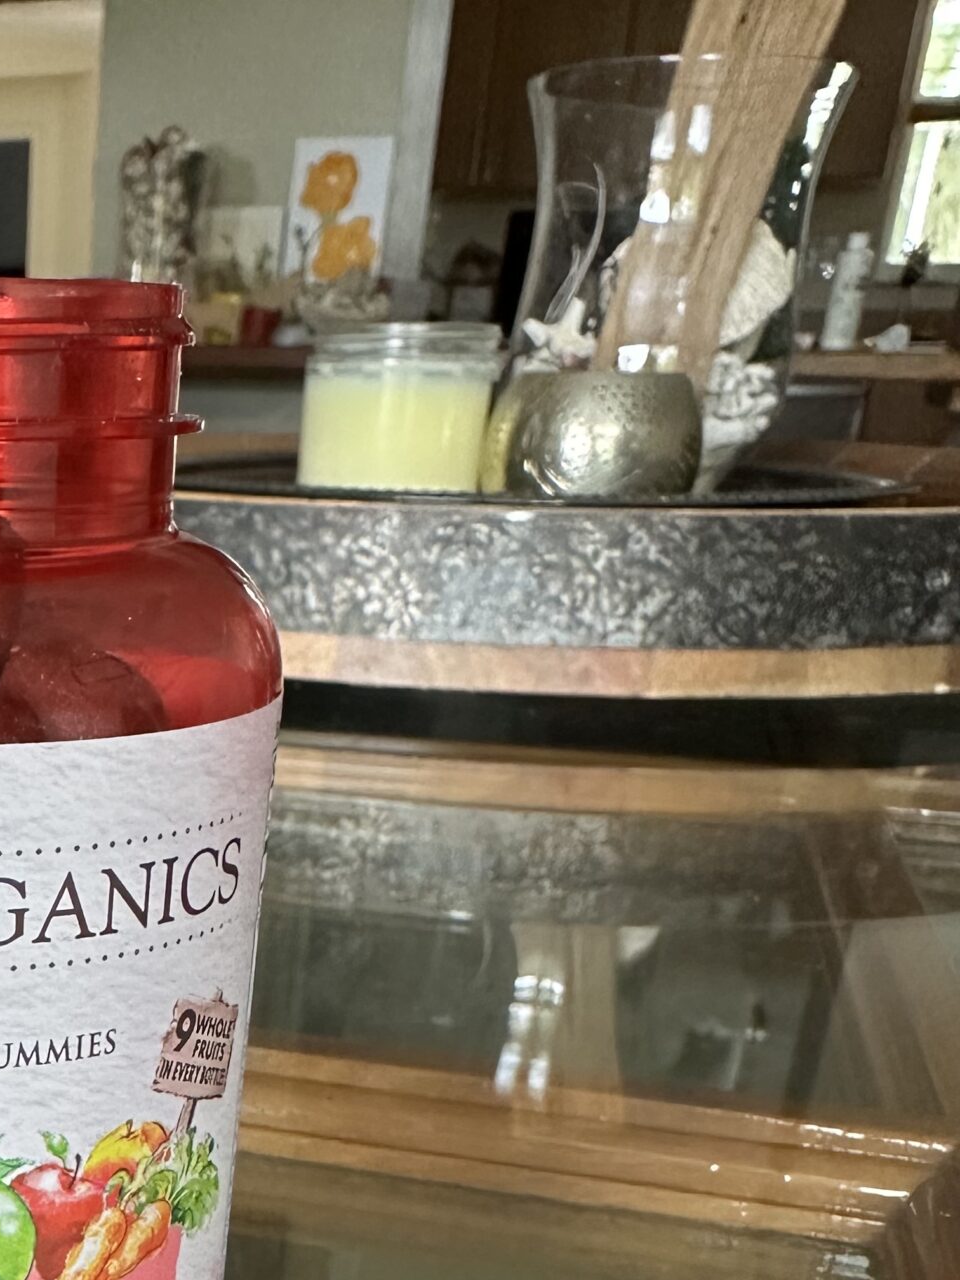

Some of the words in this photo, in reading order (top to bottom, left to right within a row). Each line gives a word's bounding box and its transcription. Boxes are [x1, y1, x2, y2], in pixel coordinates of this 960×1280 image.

[173, 1008, 197, 1052] 9
[196, 1013, 236, 1039] WHOLE
[171, 1061, 200, 1083] EVERY
